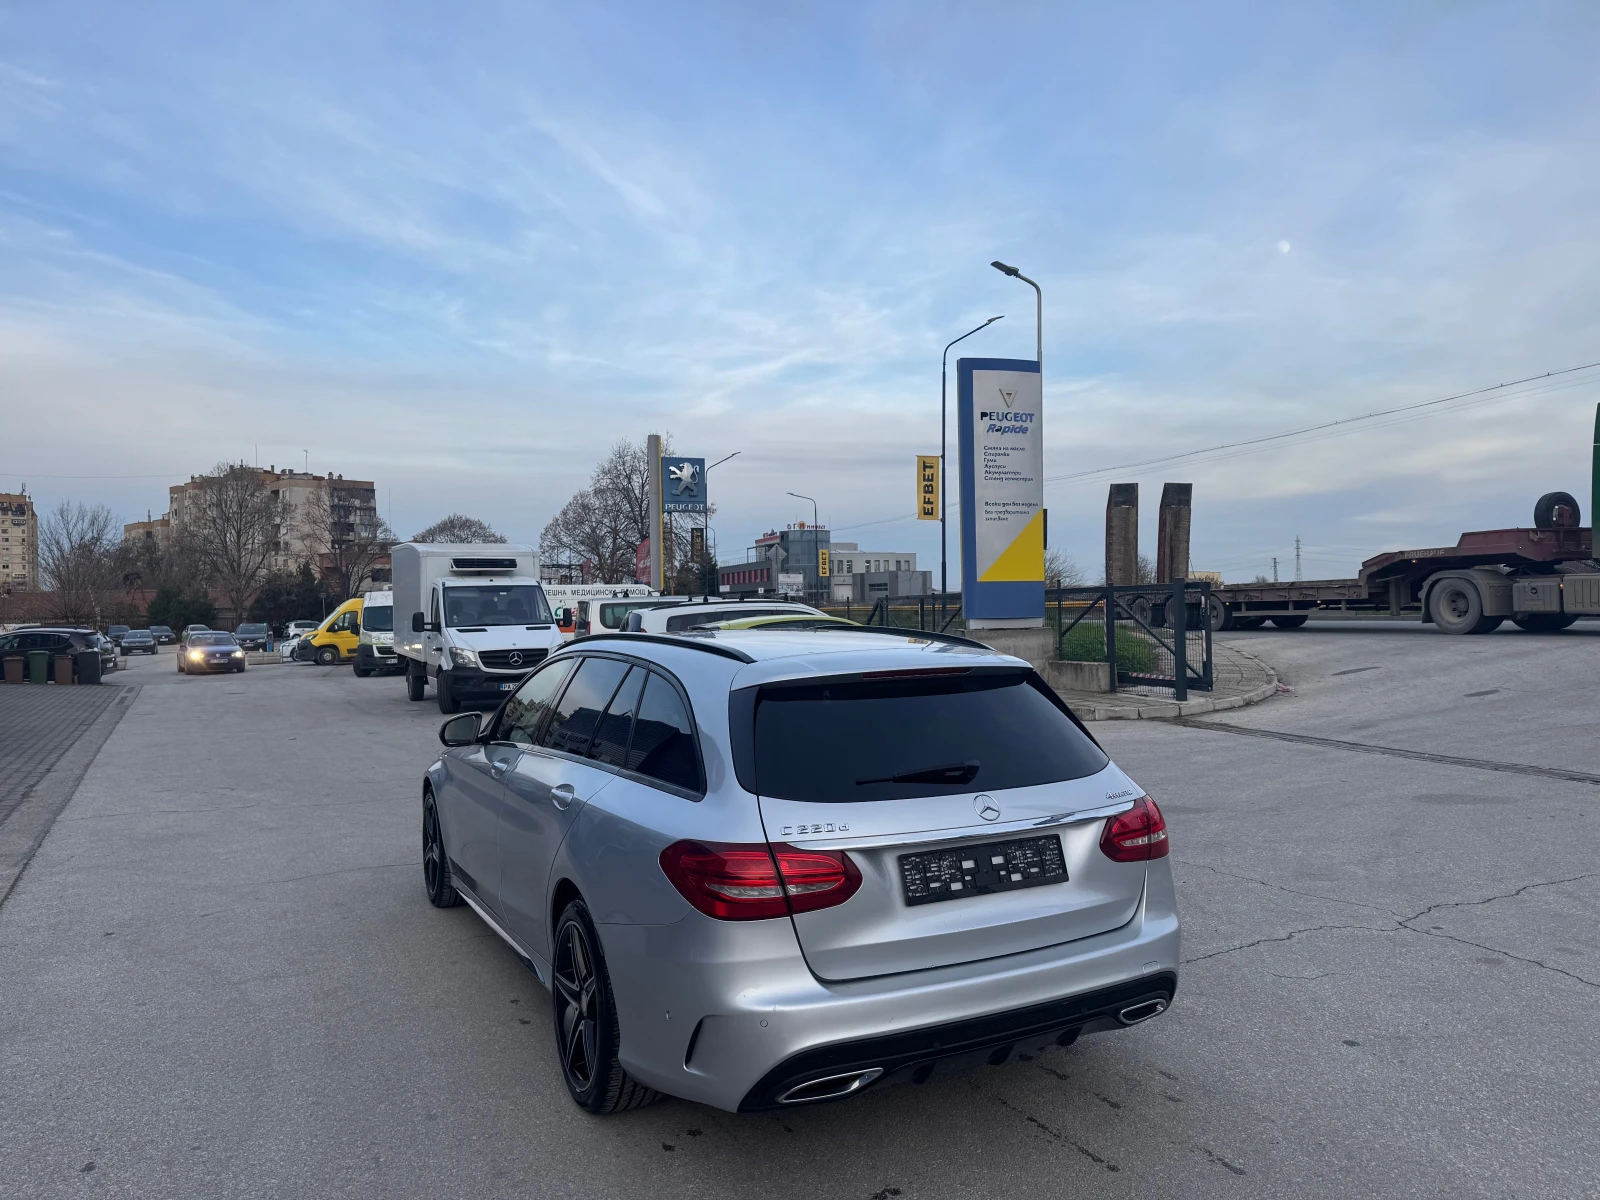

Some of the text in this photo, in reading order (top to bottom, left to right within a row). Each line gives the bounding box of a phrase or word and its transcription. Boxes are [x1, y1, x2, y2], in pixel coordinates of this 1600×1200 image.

[980, 411, 1035, 423] PEUGEOT
[986, 423, 1029, 435] Rapide
[922, 460, 935, 516] EFBET
[664, 503, 705, 511] PEUGEOT
